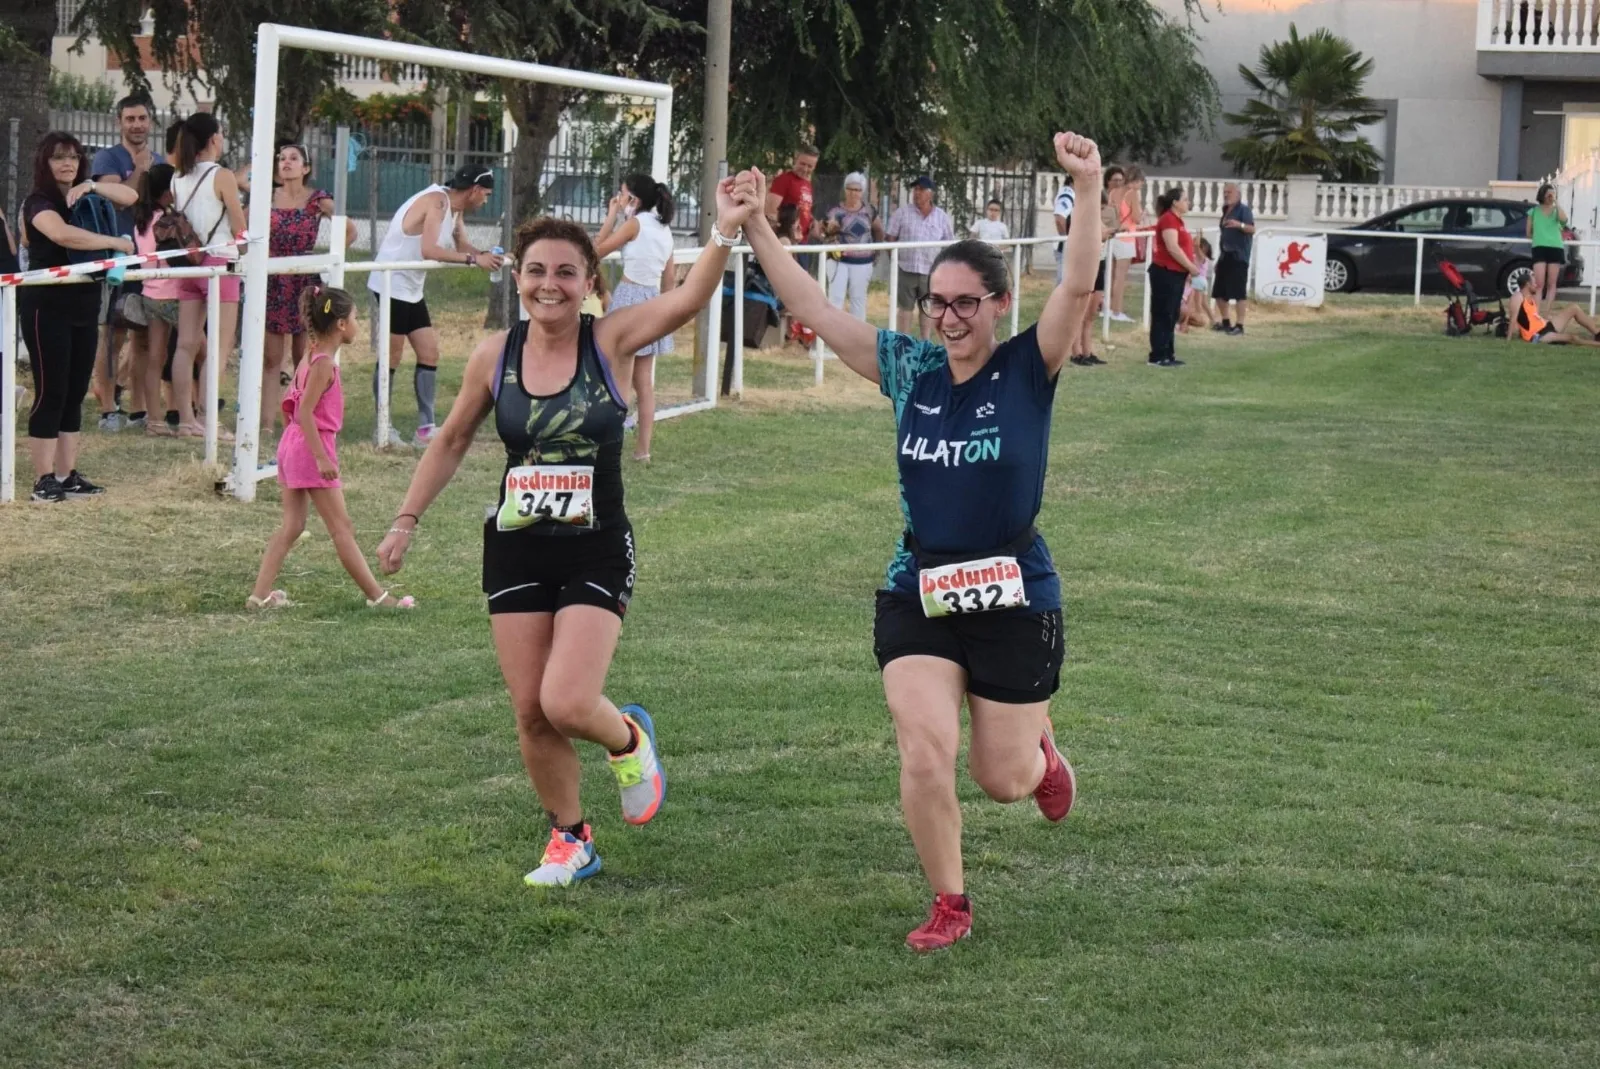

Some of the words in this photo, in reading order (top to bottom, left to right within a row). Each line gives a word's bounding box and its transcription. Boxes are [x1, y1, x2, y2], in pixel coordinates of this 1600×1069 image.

[1272, 286, 1307, 297] LESA
[901, 433, 1001, 467] LILATON
[518, 492, 573, 517] 347
[922, 562, 1020, 594] bedunia
[943, 584, 1007, 614] 332
